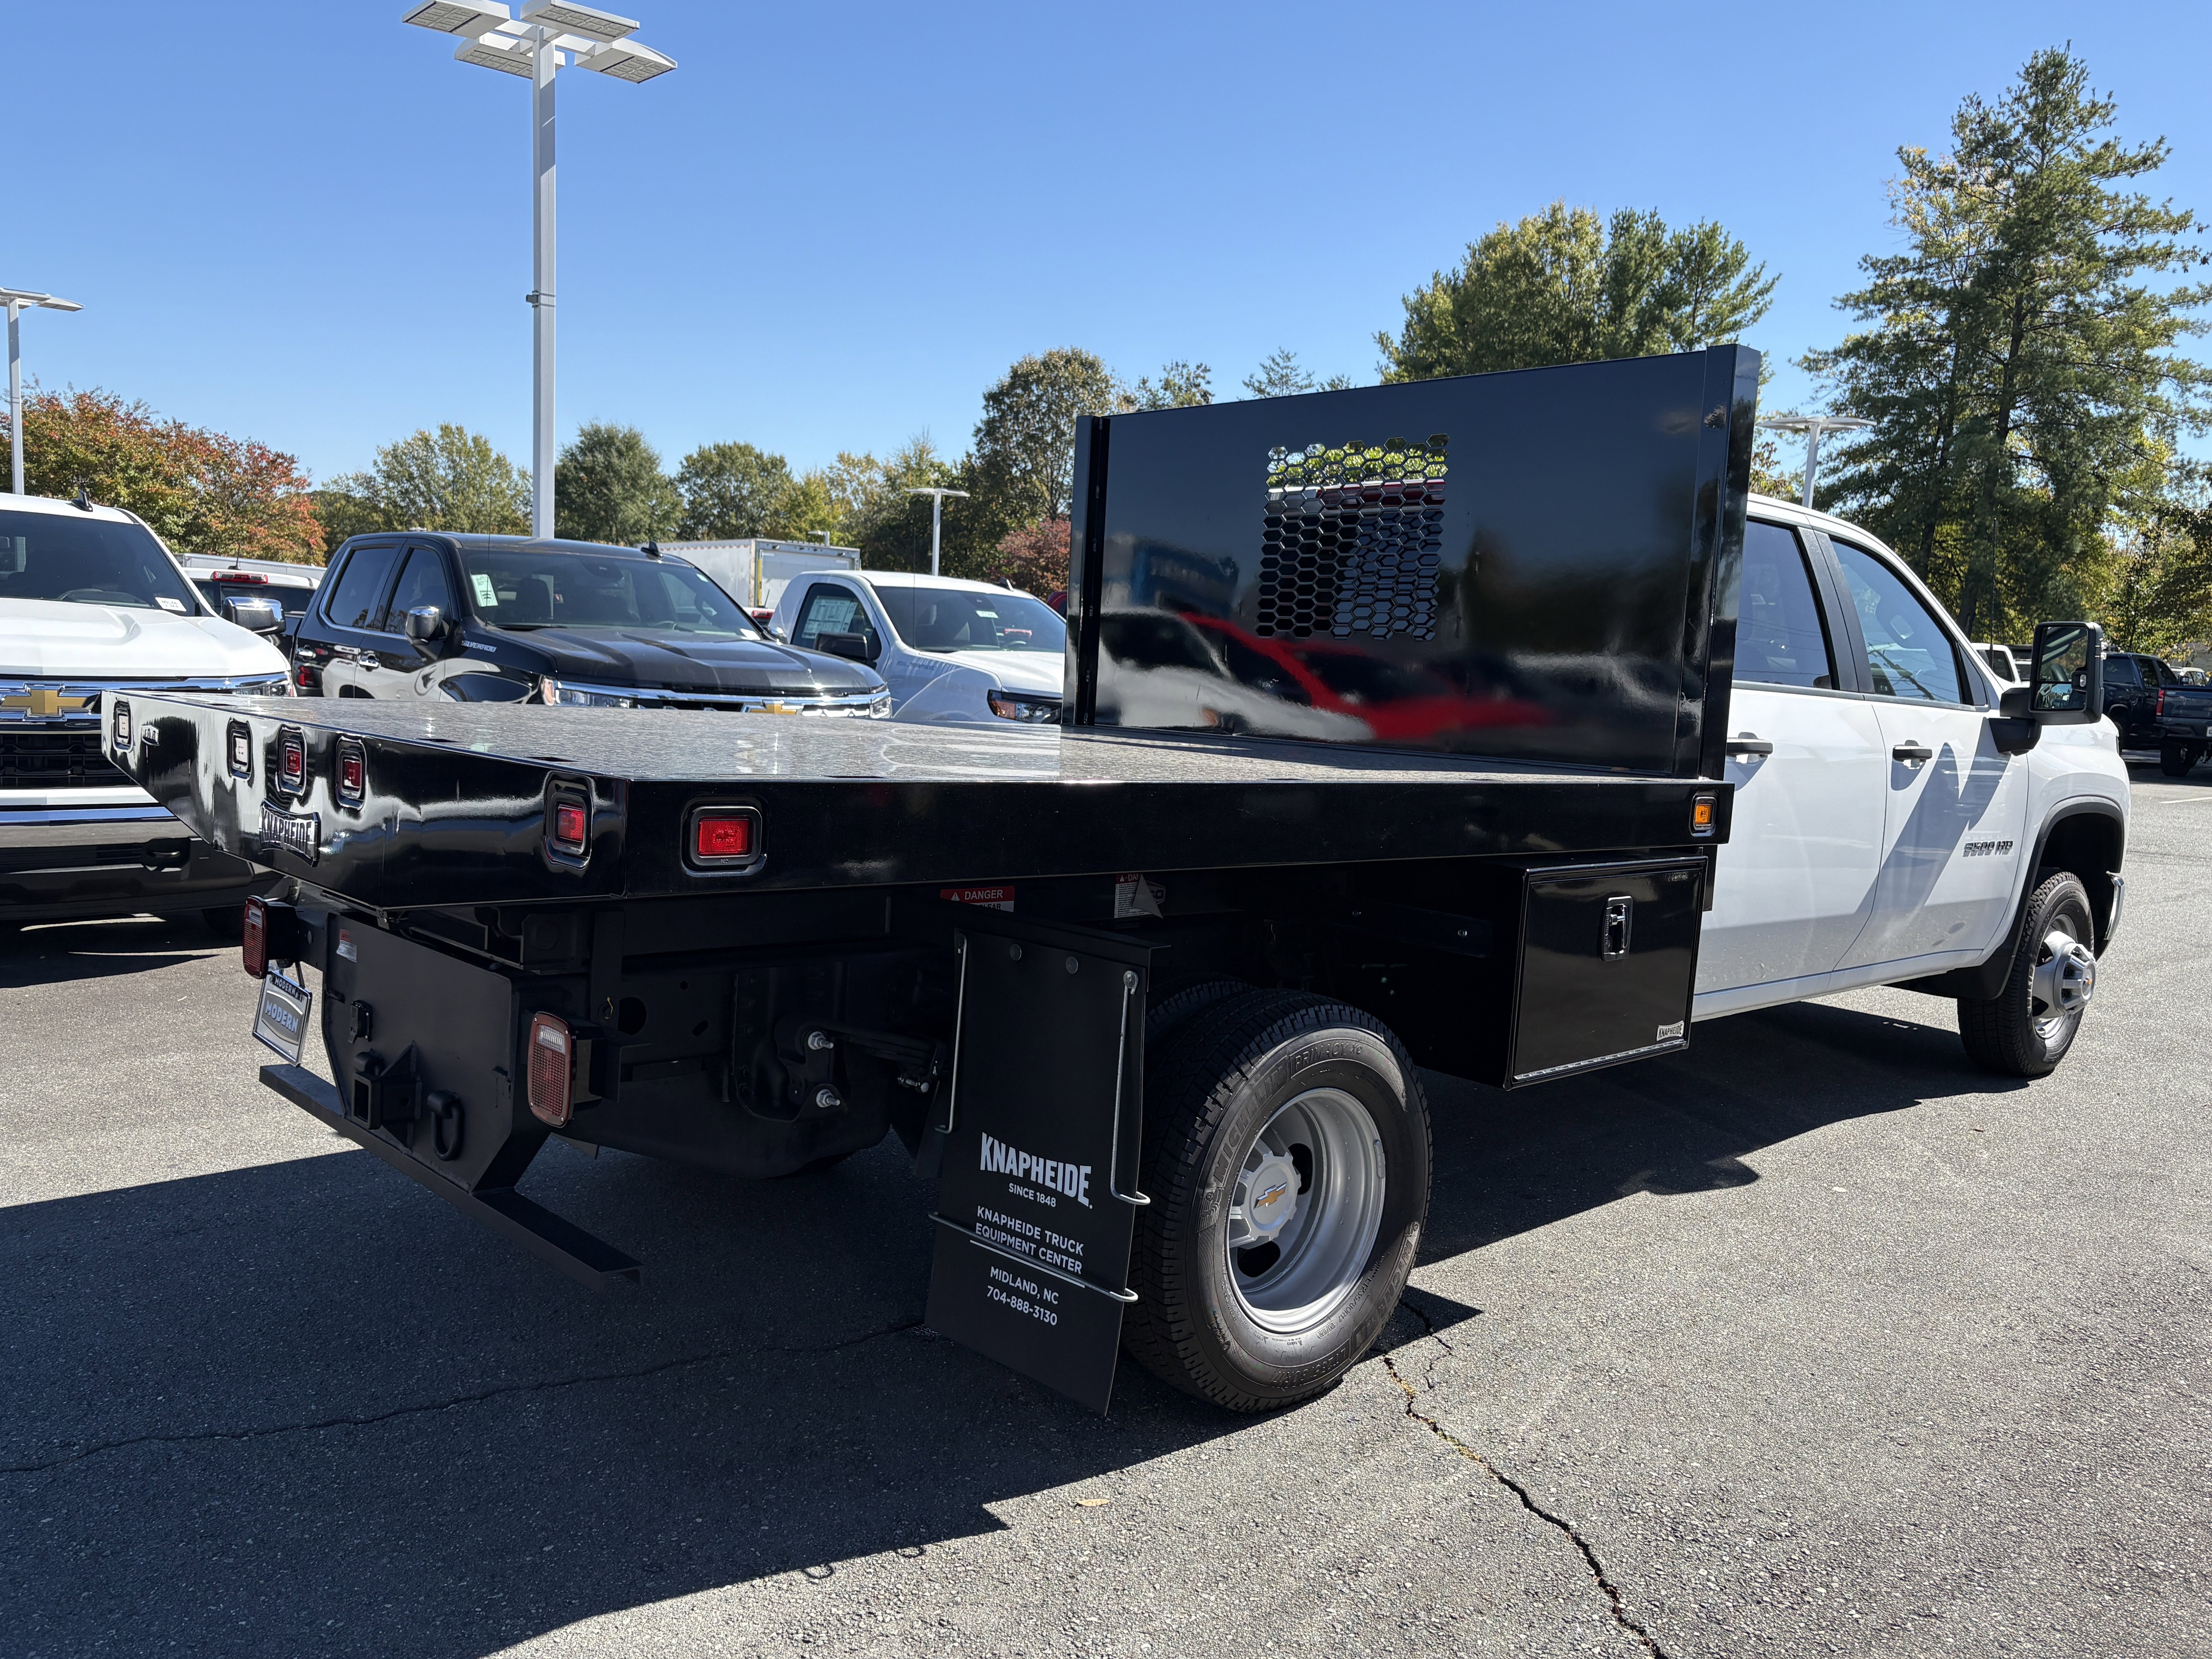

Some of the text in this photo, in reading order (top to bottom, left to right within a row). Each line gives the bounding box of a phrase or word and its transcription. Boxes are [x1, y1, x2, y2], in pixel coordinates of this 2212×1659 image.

[461, 640, 497, 653] SILVERADO
[261, 805, 314, 857] KNAPHEIDE
[965, 890, 1003, 900] DANGER
[275, 977, 296, 996] MODERN
[265, 1000, 299, 1033] MODERN
[1658, 1024, 1683, 1039] KNAPHEIDE
[1295, 1042, 1348, 1071] PRIMACY
[1213, 1060, 1288, 1184] MICHELIN
[1008, 1183, 1056, 1207] SINCE 1848
[977, 1205, 1084, 1256] KNAPHEIDE TRUCK
[975, 1222, 1082, 1274] EQUIPMENT CENTER
[990, 1266, 1059, 1304] MIDLAND, NC
[987, 1285, 1058, 1326] 704-888-3130
